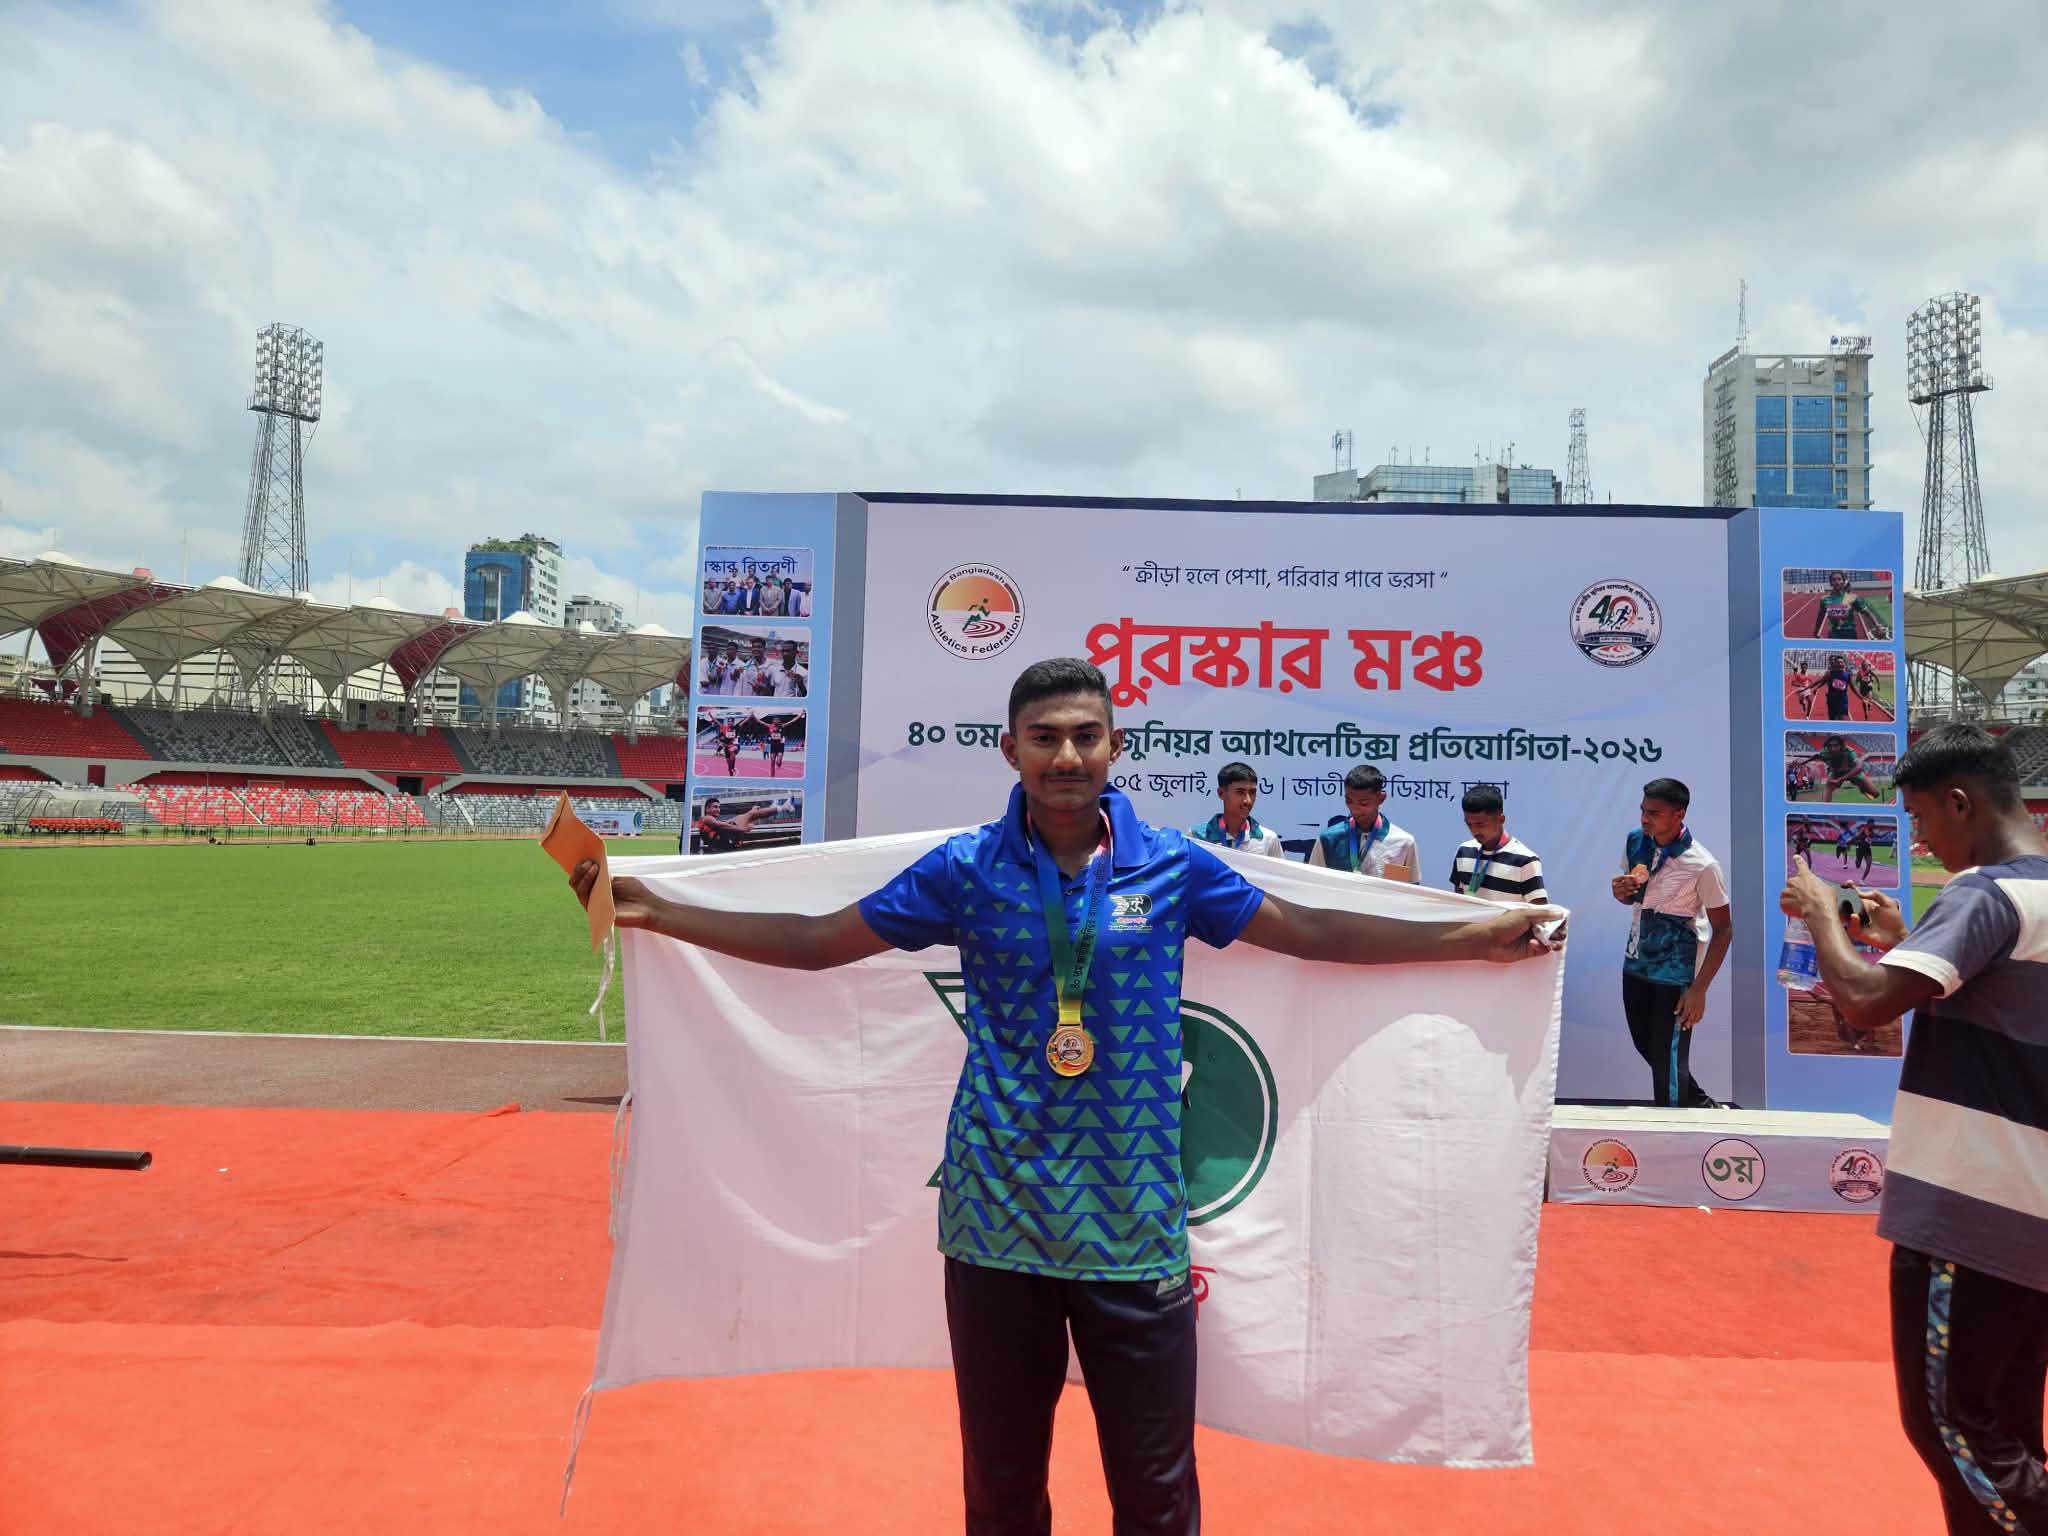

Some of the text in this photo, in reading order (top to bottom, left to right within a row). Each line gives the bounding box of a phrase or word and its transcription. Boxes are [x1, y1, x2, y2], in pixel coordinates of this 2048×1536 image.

[949, 567, 1005, 584] Bangladesh
[1134, 560, 1436, 589] ক্রীড়া হলে পেশা, পরিবার পাবে ভরসা
[930, 613, 1021, 654] Athletics Federation
[1085, 617, 1483, 708] পুরস্কার মঞ্চ
[908, 721, 946, 747] ৪০
[955, 723, 1003, 748] তম
[1220, 721, 1401, 762] অ্যাথলেটিক্স
[1408, 727, 1663, 764] প্রতিযোগিতা-২০২৬
[1147, 771, 1213, 797] জুলাই,
[1291, 772, 1345, 797] জাতী
[1382, 774, 1455, 801] ডিয়াম,
[1705, 1156, 1760, 1184] ৩য়
